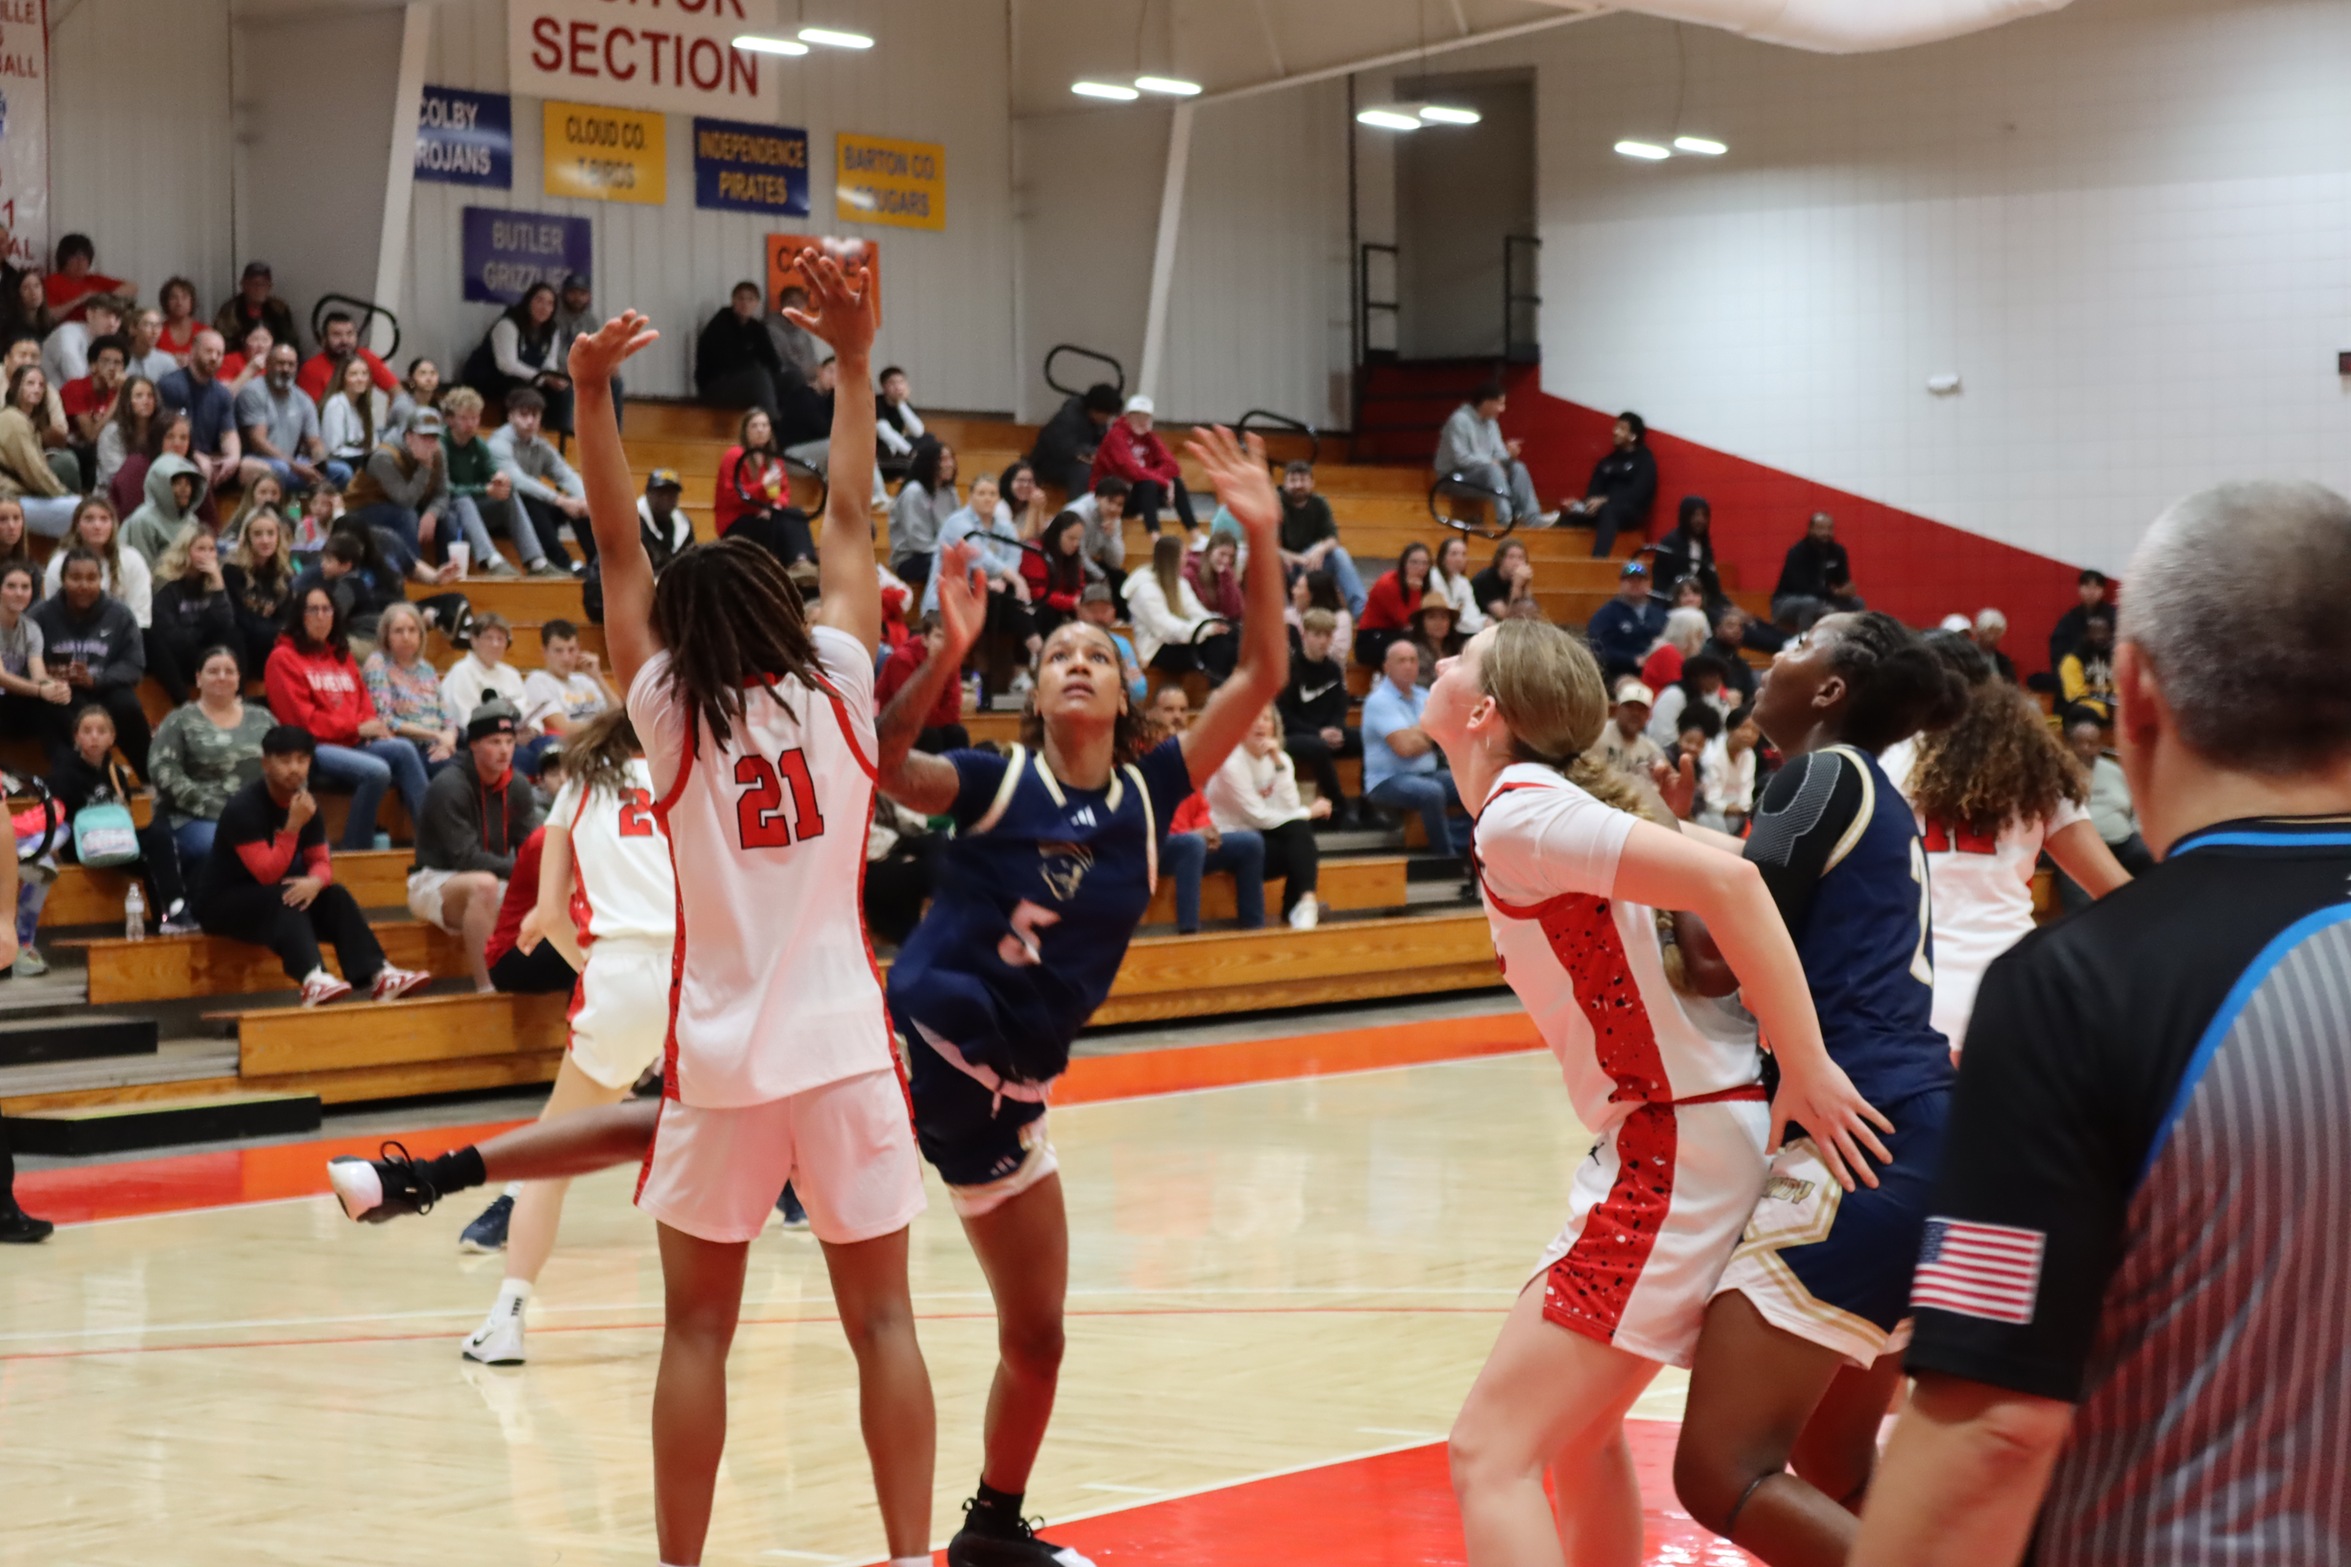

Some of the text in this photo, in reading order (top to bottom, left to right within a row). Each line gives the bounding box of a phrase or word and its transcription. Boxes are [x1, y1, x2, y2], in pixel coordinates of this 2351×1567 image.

[0, 53, 38, 79] ALL
[531, 15, 759, 98] SECTION
[566, 114, 619, 148] CLOUD
[699, 130, 805, 169] INDEPENDENCE
[415, 137, 491, 175] ROJANS
[845, 144, 908, 177] BARTON
[719, 170, 788, 205] PIRATES
[492, 219, 564, 256] BUTLER
[618, 788, 654, 837] 2
[733, 747, 825, 851] 21
[997, 897, 1061, 968] 5
